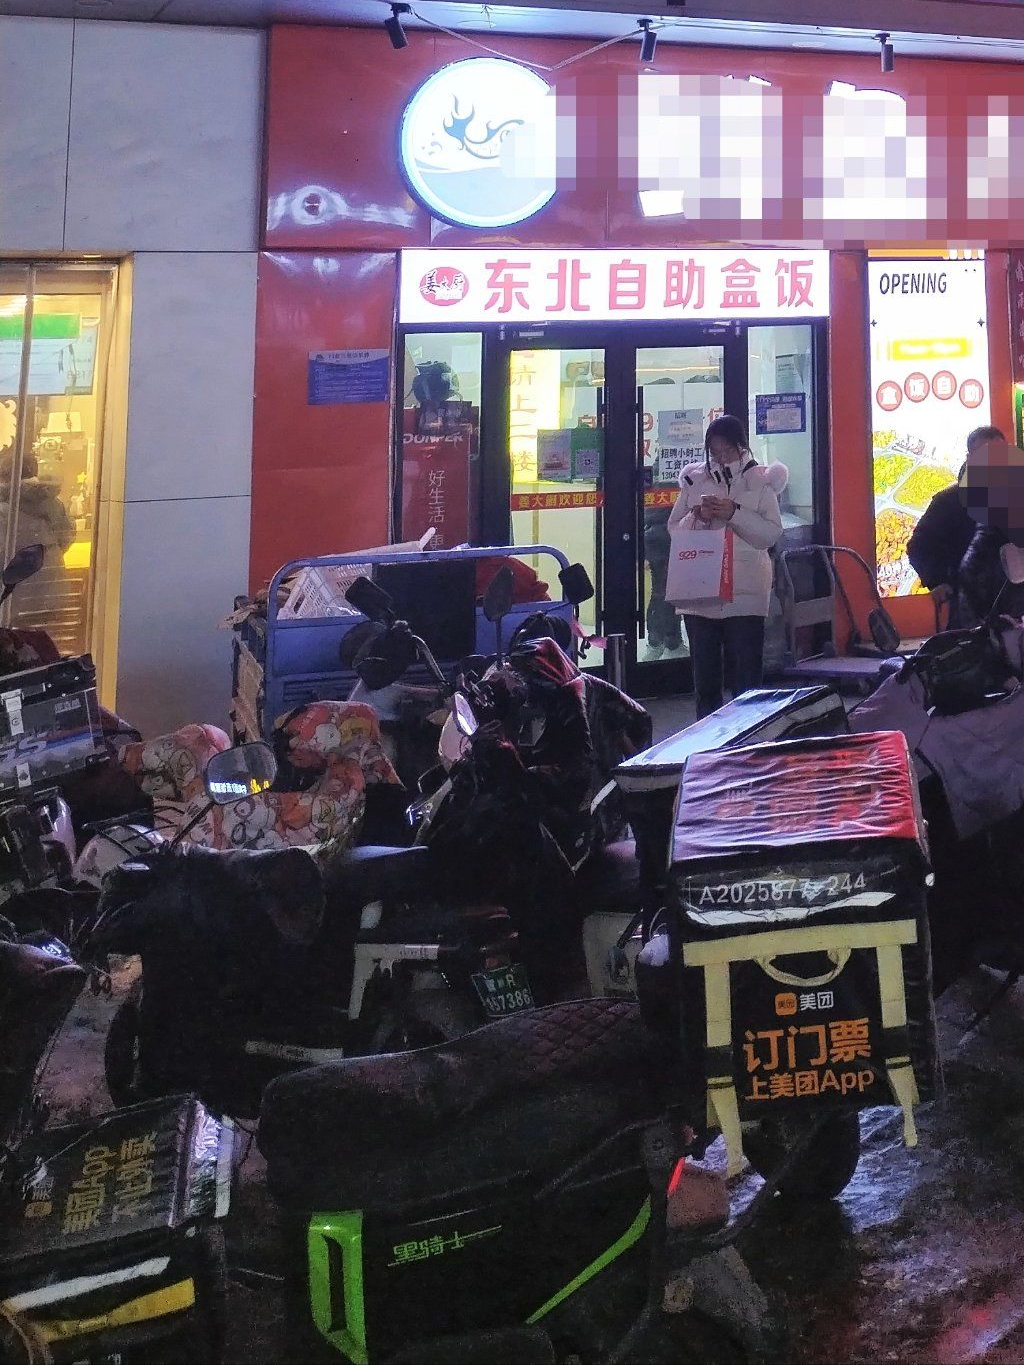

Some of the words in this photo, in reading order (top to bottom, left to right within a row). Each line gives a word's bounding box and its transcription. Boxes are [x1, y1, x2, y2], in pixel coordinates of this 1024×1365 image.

[484, 258, 814, 314] 东北自助盒饭
[879, 272, 947, 295] OPENING
[660, 448, 703, 459] 招聘小时工
[428, 470, 446, 523] 好生活
[679, 550, 697, 561] 929
[800, 991, 834, 1011] 美团
[742, 1017, 872, 1072] 订门票
[744, 1069, 875, 1101] 上美团App
